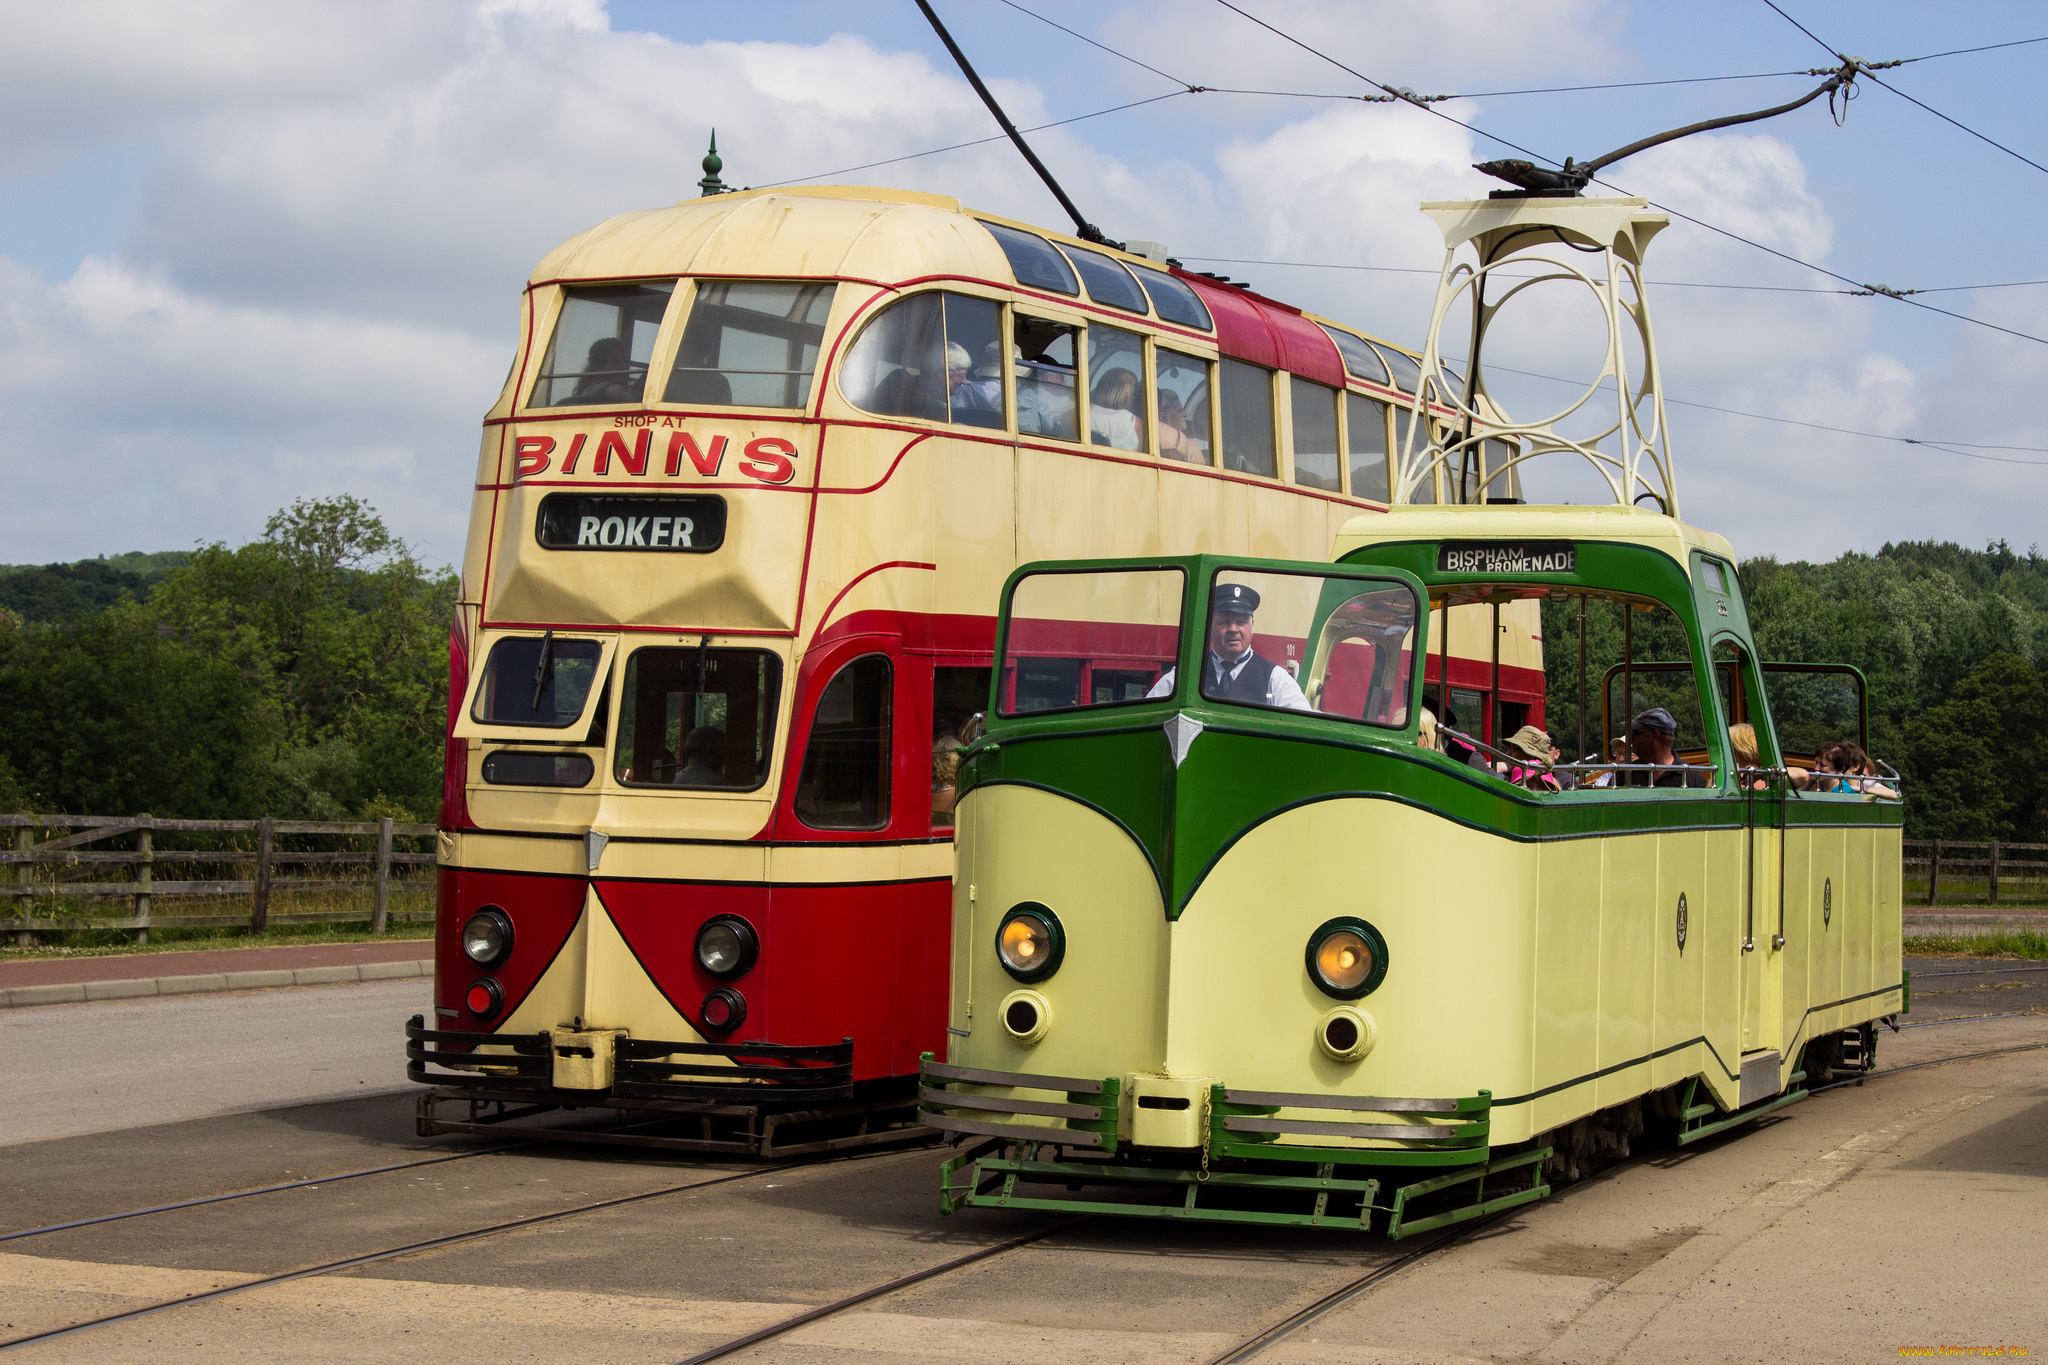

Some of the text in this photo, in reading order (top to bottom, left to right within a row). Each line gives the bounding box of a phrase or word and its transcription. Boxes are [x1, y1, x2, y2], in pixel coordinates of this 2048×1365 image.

[614, 416, 686, 428] SHOP AT
[513, 428, 799, 485] BINNS
[577, 516, 695, 547] ROKER
[1447, 548, 1524, 570] BISPHAM
[1486, 550, 1575, 573] PROMENADE
[1287, 644, 1295, 656] 101
